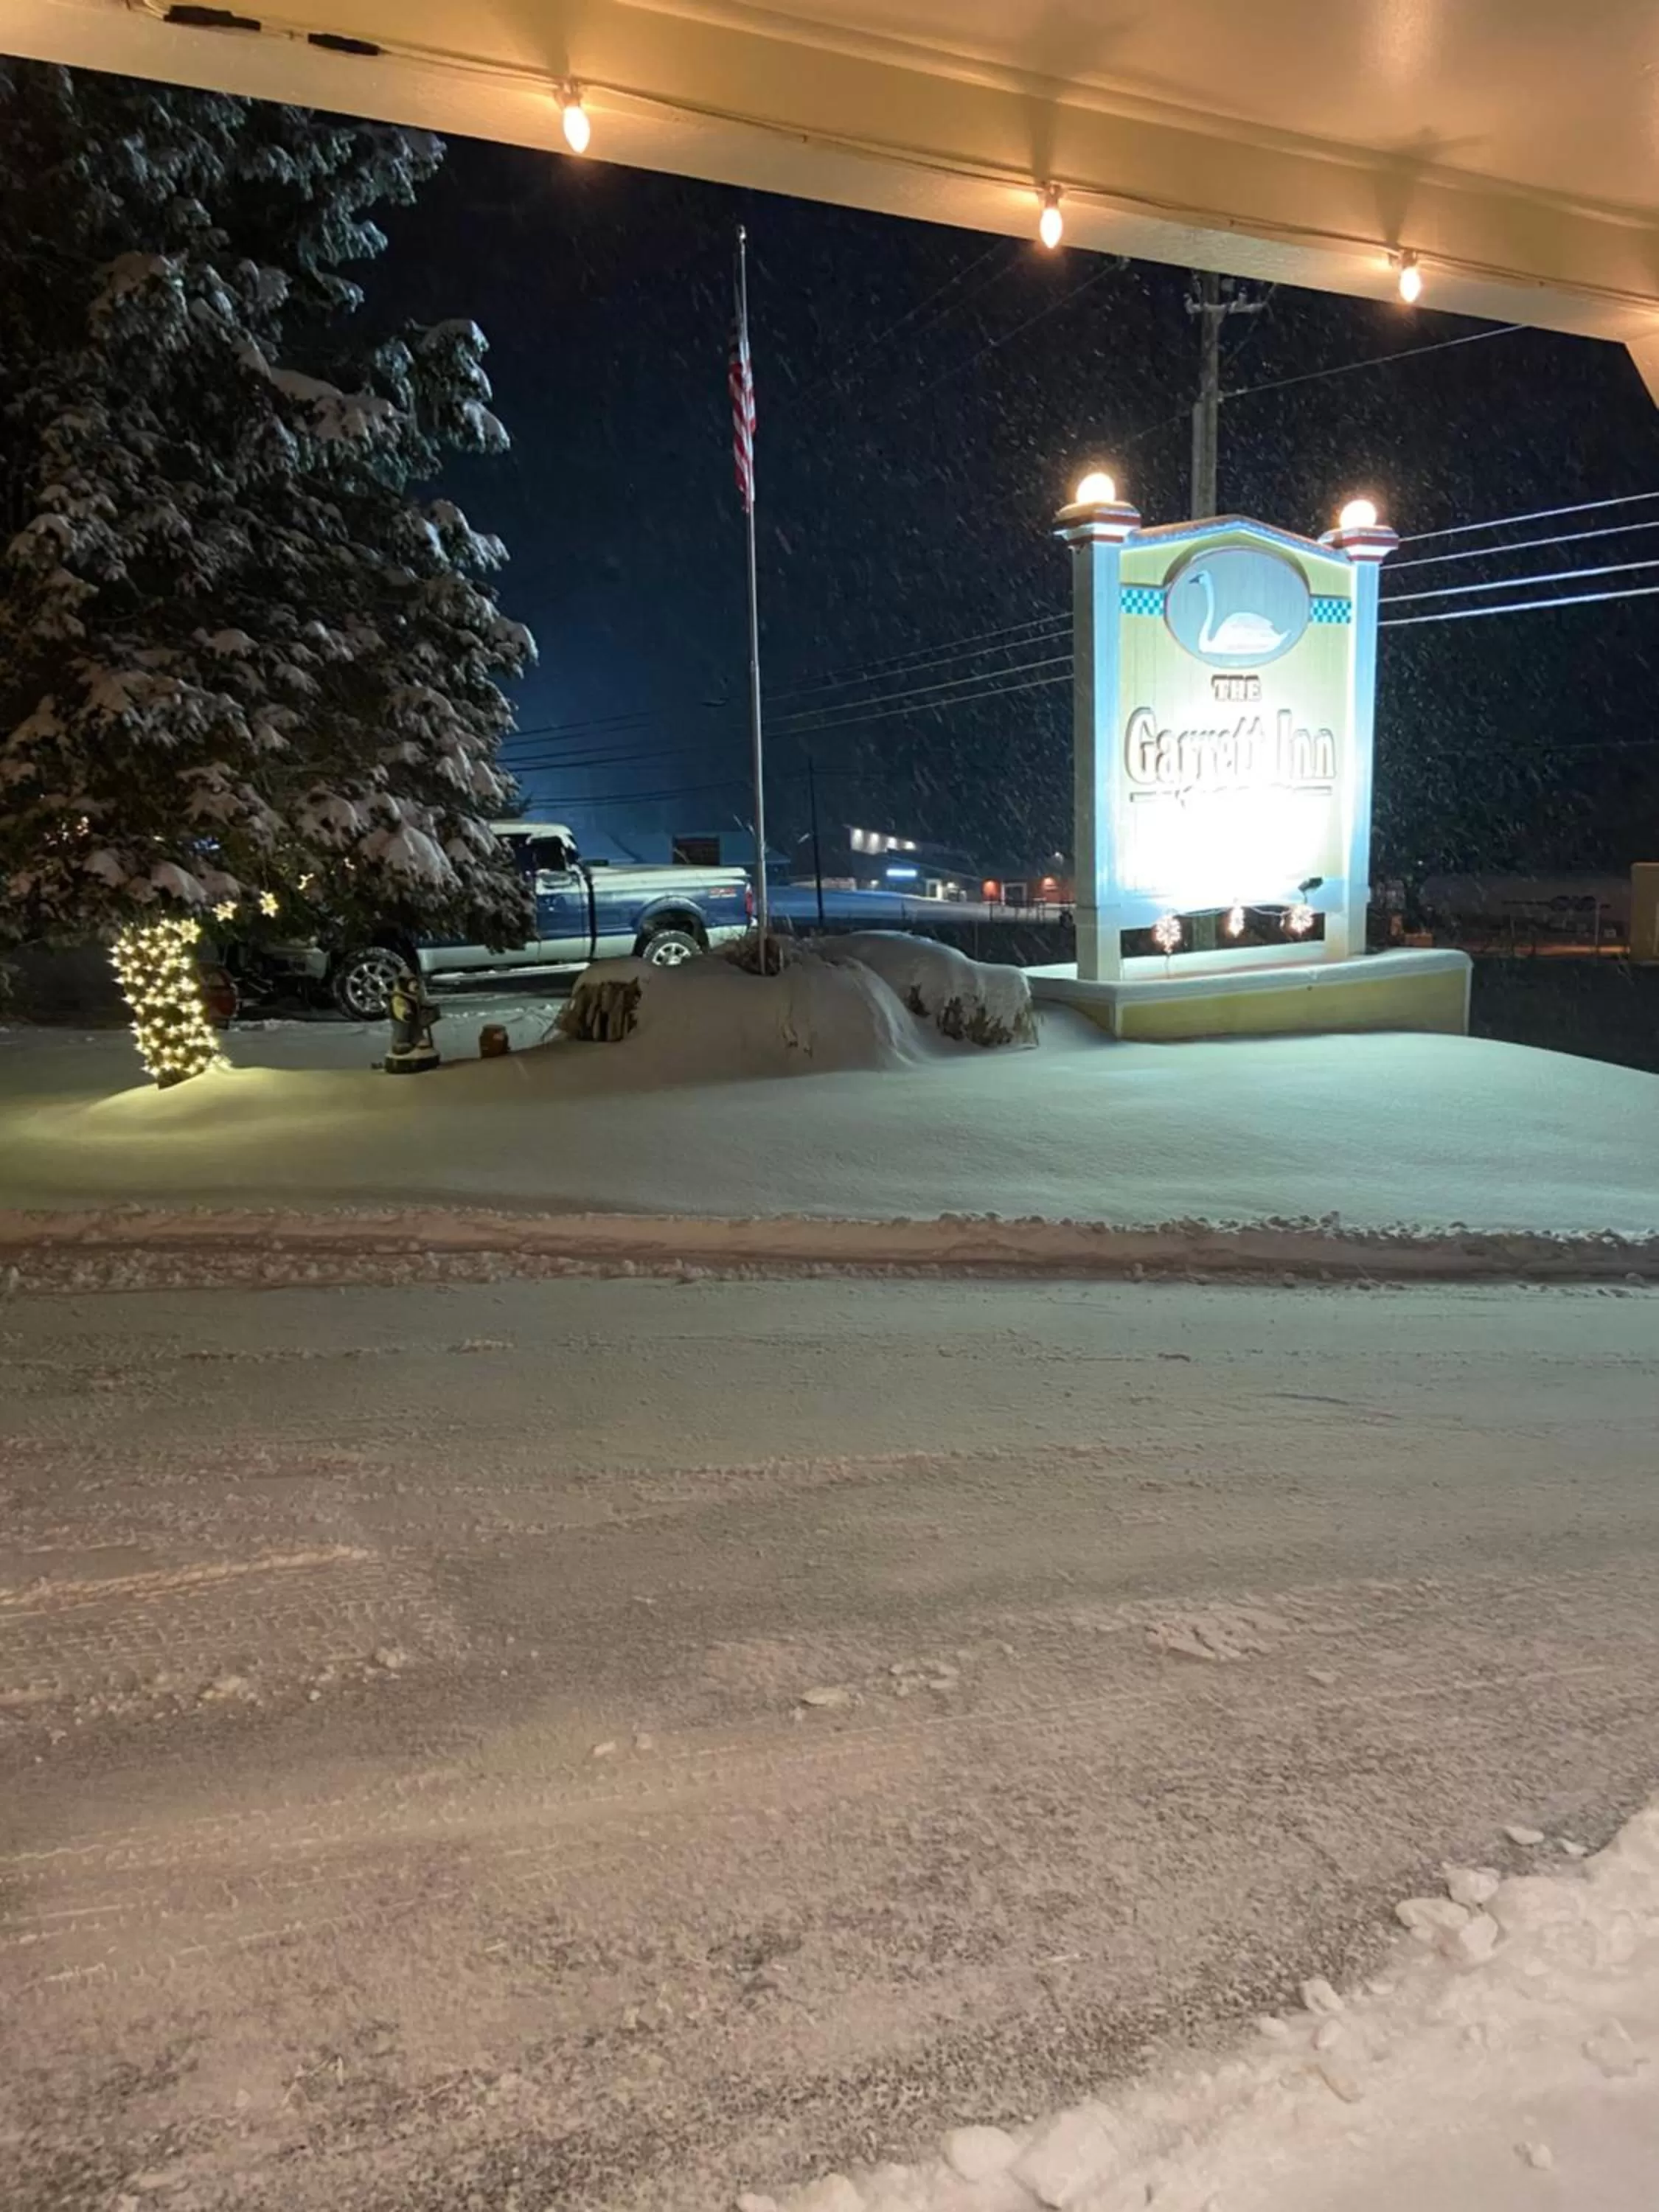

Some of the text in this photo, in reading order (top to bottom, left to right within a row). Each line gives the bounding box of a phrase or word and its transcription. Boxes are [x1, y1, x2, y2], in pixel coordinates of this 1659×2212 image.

[1211, 674, 1262, 701] THE
[1124, 706, 1336, 785] Garrett Inn
